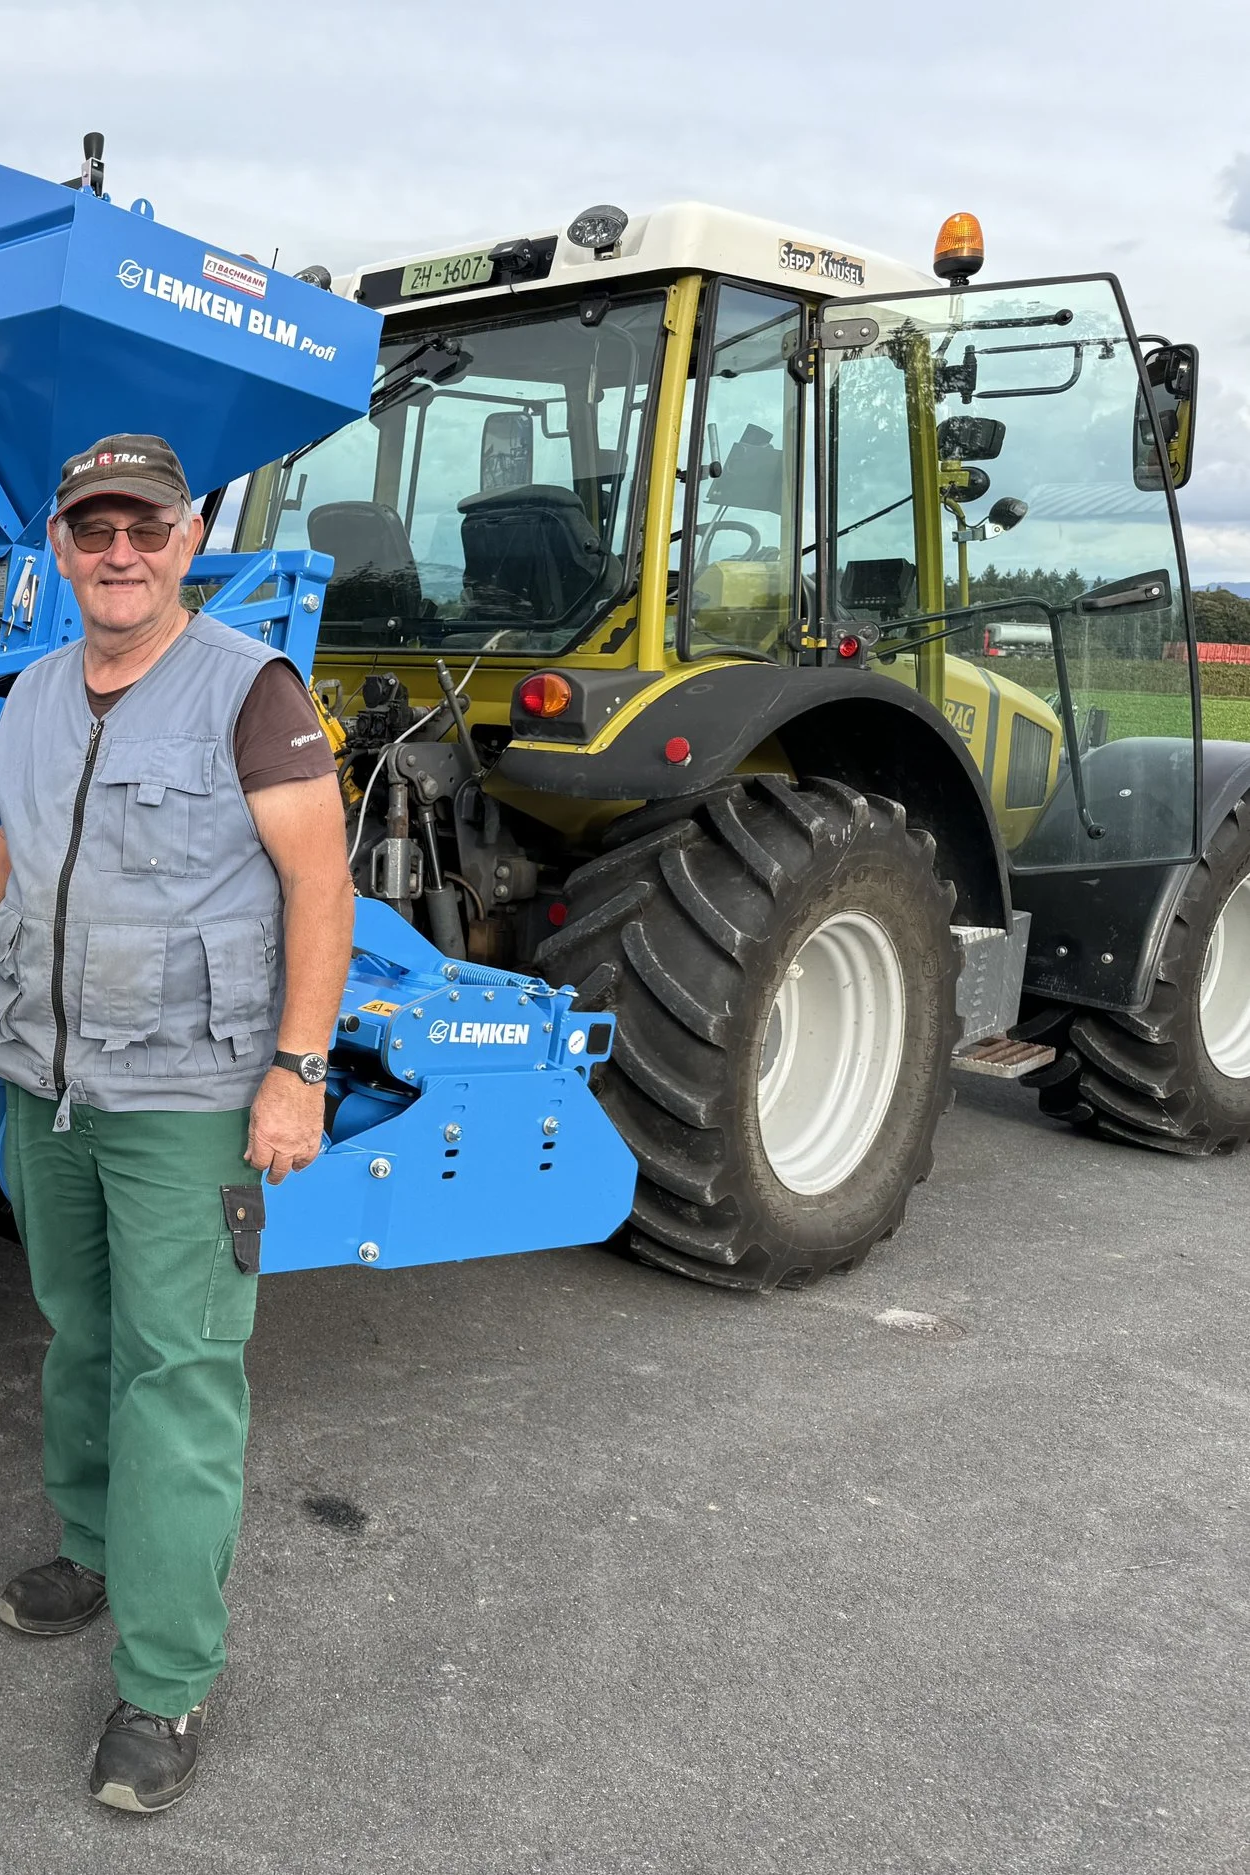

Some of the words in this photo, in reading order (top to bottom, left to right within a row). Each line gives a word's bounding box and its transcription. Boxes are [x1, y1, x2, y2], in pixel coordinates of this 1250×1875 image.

[217, 264, 266, 288] BACHMANN
[143, 268, 244, 328] LEMKEN
[248, 308, 298, 348] BLM
[299, 336, 337, 362] Profi
[72, 457, 95, 476] RIGI
[114, 454, 147, 464] TRAC
[944, 701, 975, 731] RAC
[448, 1022, 530, 1048] LEMKEN
